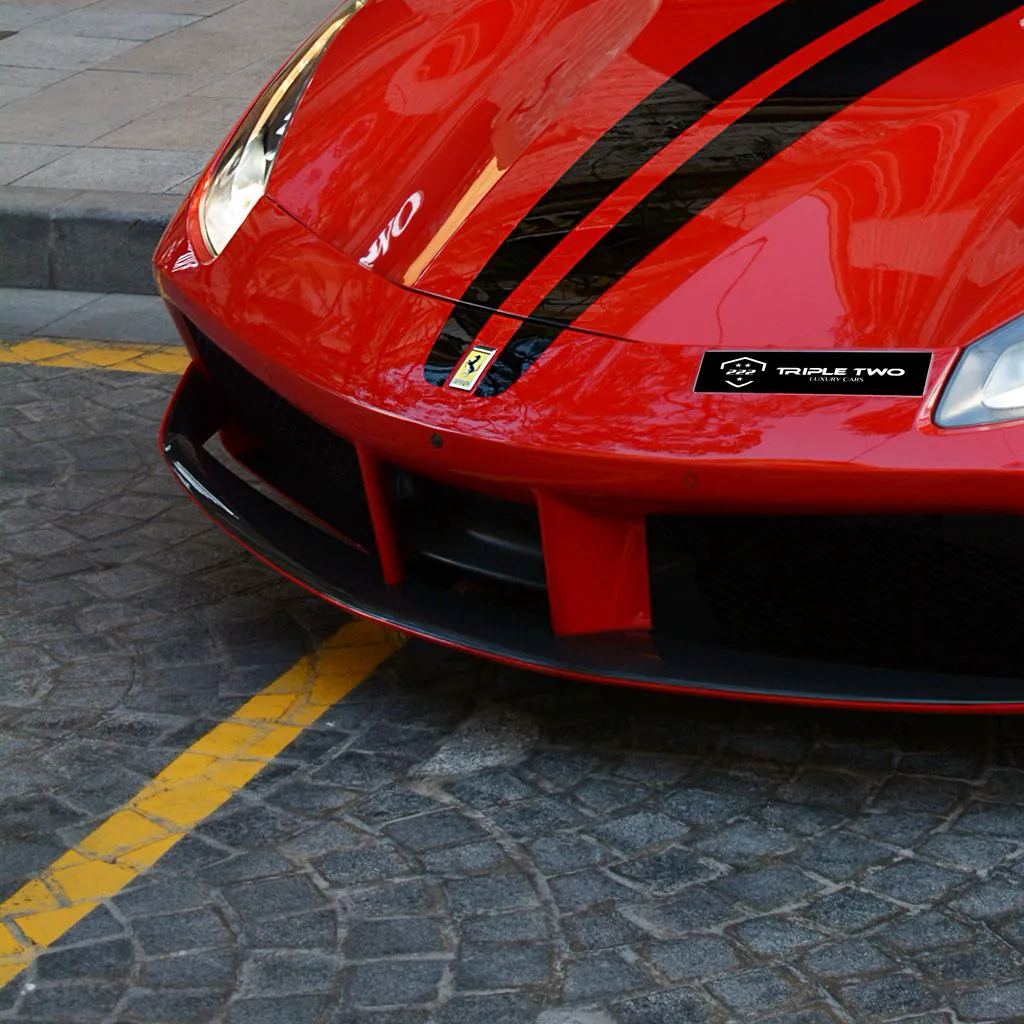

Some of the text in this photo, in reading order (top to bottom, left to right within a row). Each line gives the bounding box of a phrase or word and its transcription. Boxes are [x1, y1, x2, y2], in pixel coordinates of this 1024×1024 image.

[726, 368, 757, 376] 222
[776, 367, 906, 377] TRIPLE TWO
